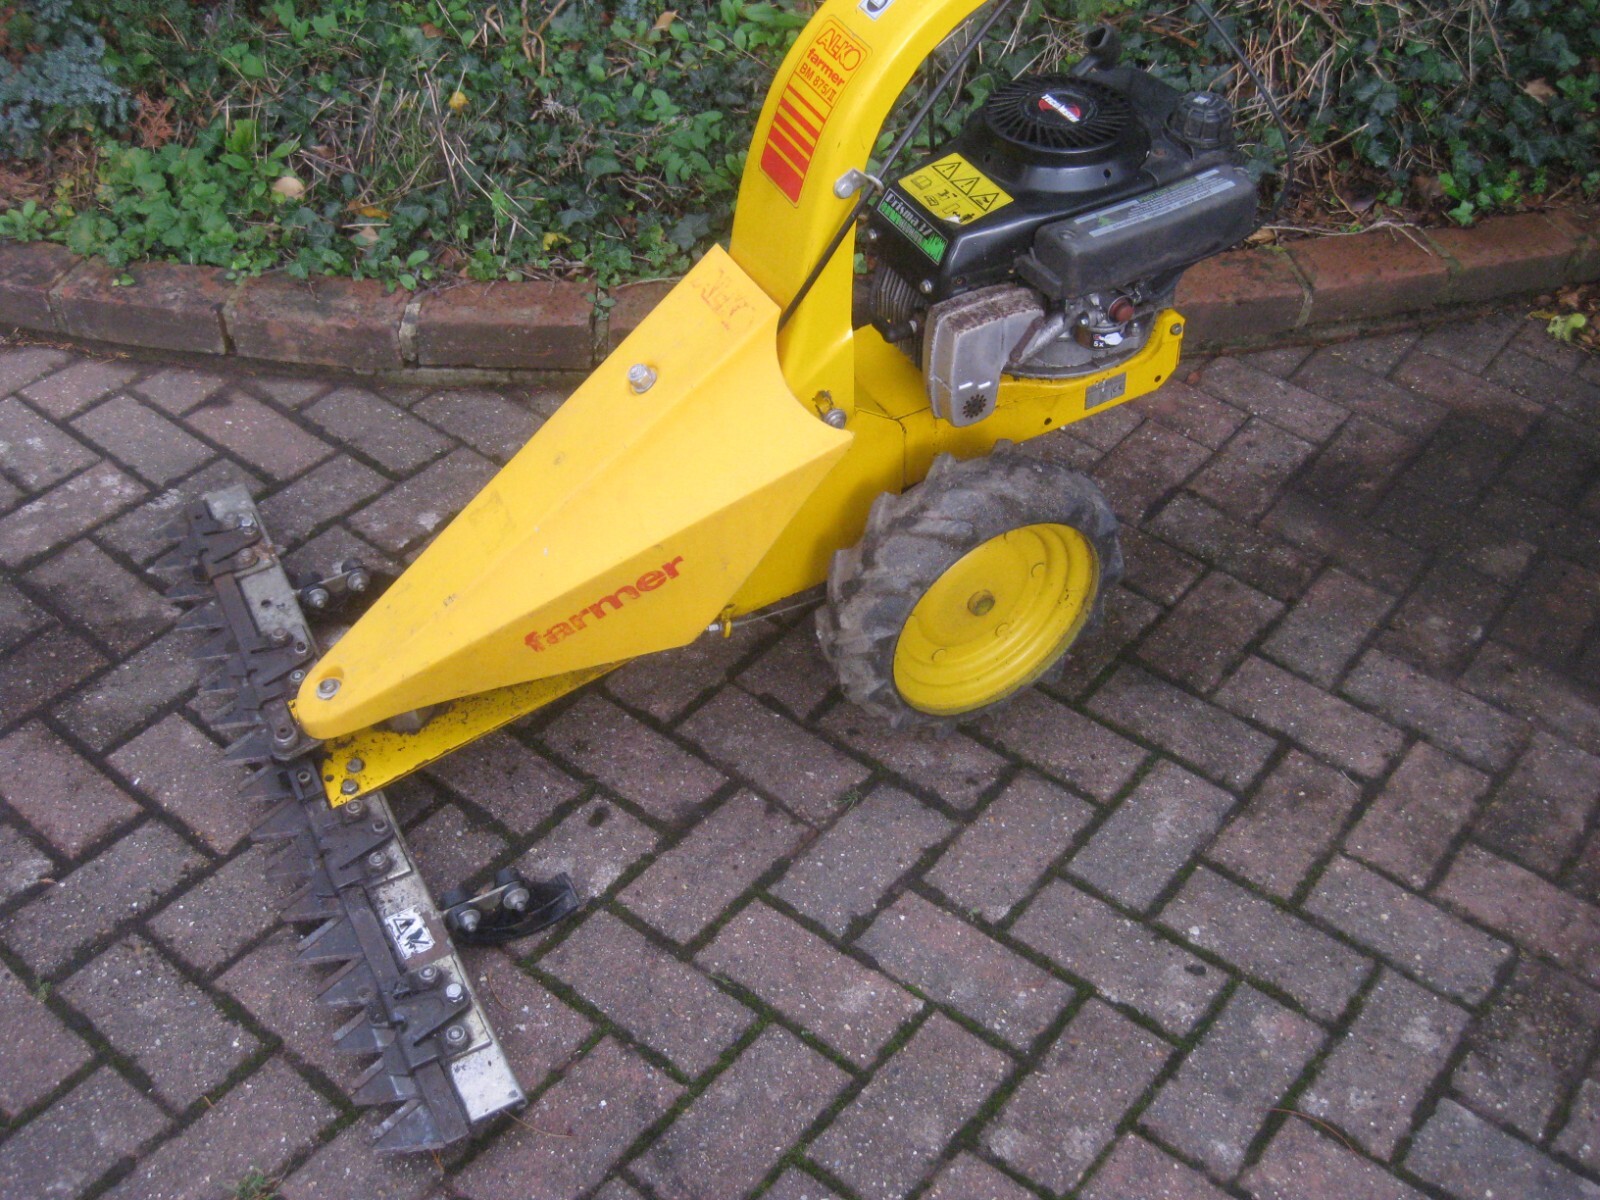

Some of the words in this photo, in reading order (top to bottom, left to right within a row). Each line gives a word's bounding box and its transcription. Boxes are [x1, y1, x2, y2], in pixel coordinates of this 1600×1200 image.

[800, 62, 815, 81] BM
[807, 48, 845, 86] farmer
[885, 192, 920, 227] Prisma
[524, 555, 684, 653] farmer
